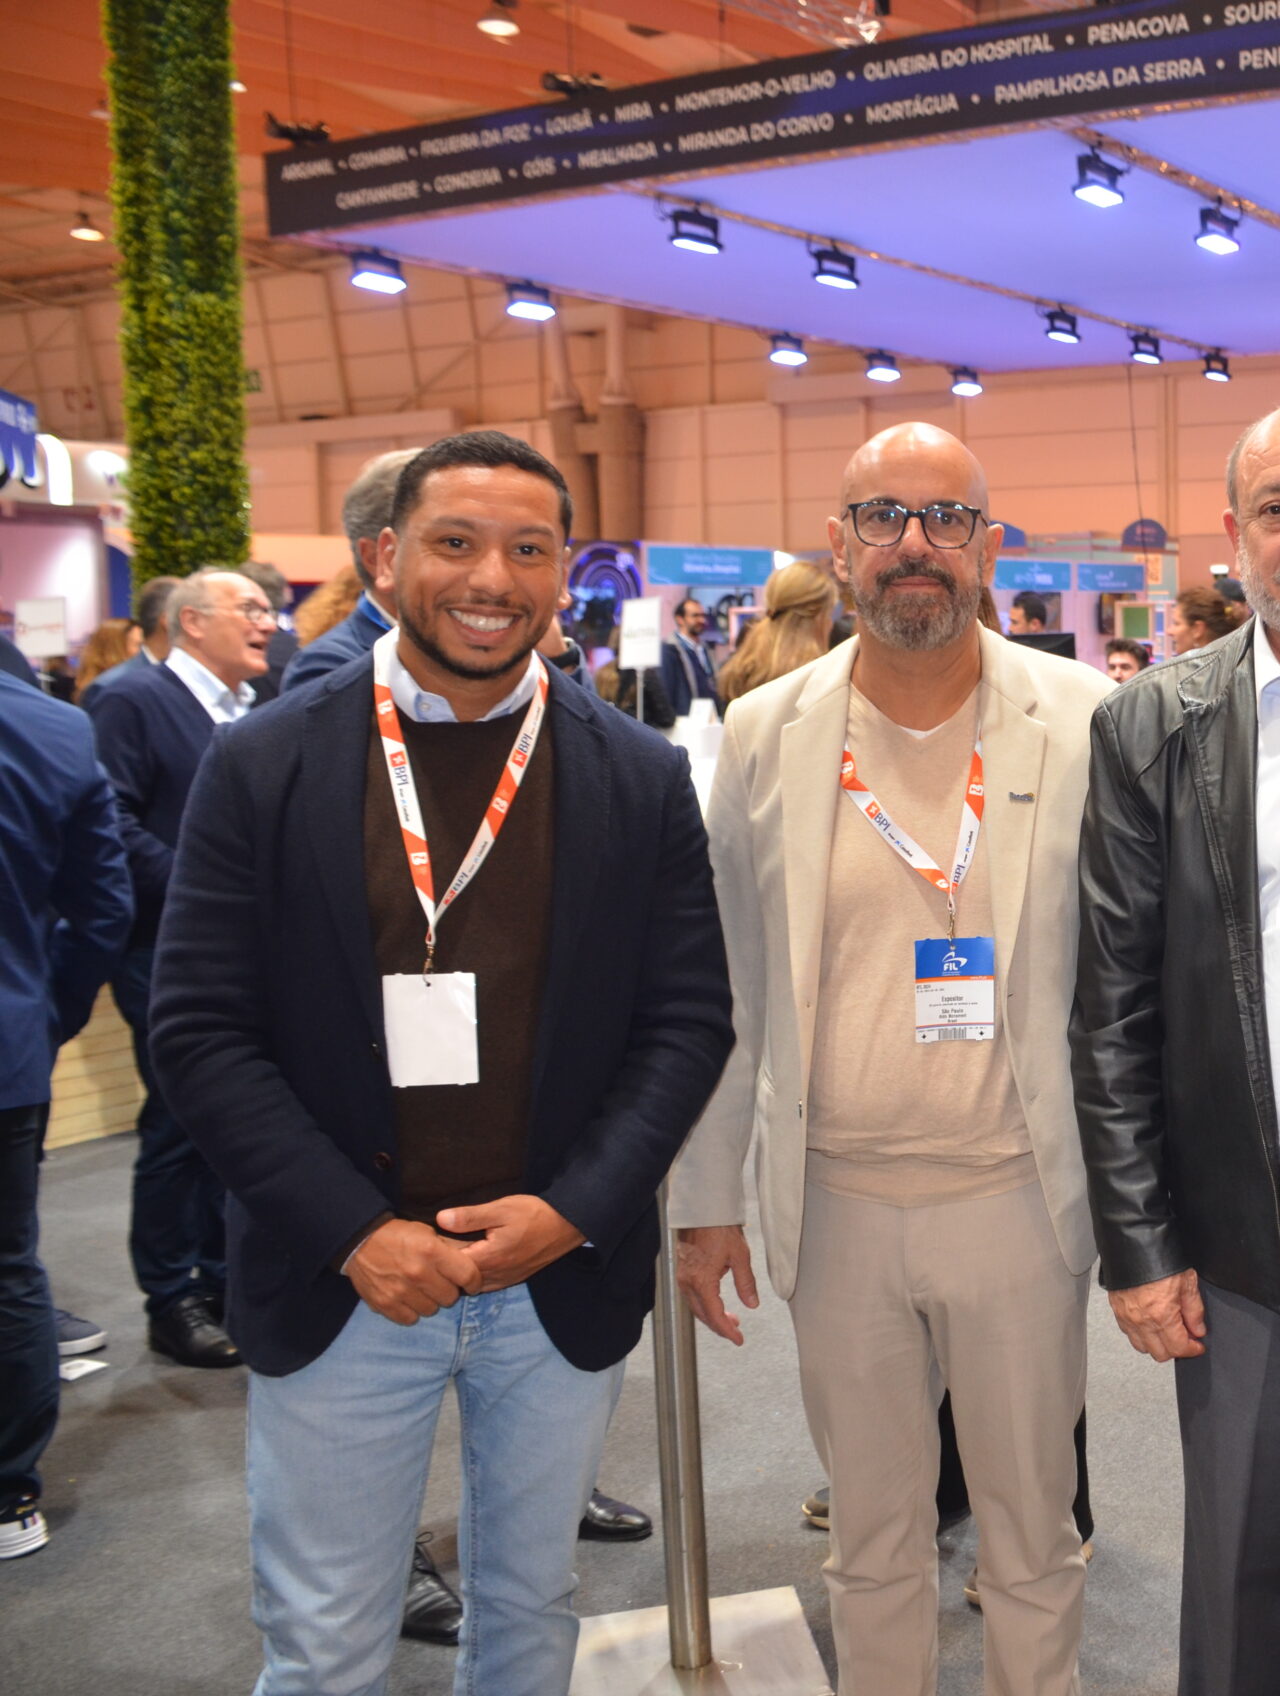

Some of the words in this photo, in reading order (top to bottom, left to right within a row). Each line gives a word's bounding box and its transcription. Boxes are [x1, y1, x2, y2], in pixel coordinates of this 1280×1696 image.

[545, 107, 593, 136] LOUSÃ
[615, 101, 654, 124] MIRA
[674, 69, 836, 113] MONTEMOR-O-VELHO
[863, 53, 938, 82] OLIVEIRA
[941, 45, 969, 68] DO
[970, 32, 1054, 65] HOSPITAL
[1087, 12, 1190, 46] PENACOVA
[578, 141, 658, 170] MEALHADA
[678, 126, 750, 155] MIRANDA
[750, 121, 775, 142] DO
[776, 112, 835, 138] CORVO
[865, 92, 959, 124] MORTÁGUA
[994, 70, 1109, 104] PAMPILHOSA
[1112, 64, 1141, 86] DA
[1143, 57, 1206, 83] SERRA
[519, 733, 533, 754] BPI
[394, 766, 410, 786] BPI
[873, 812, 891, 831] BPI
[943, 962, 958, 971] FIL
